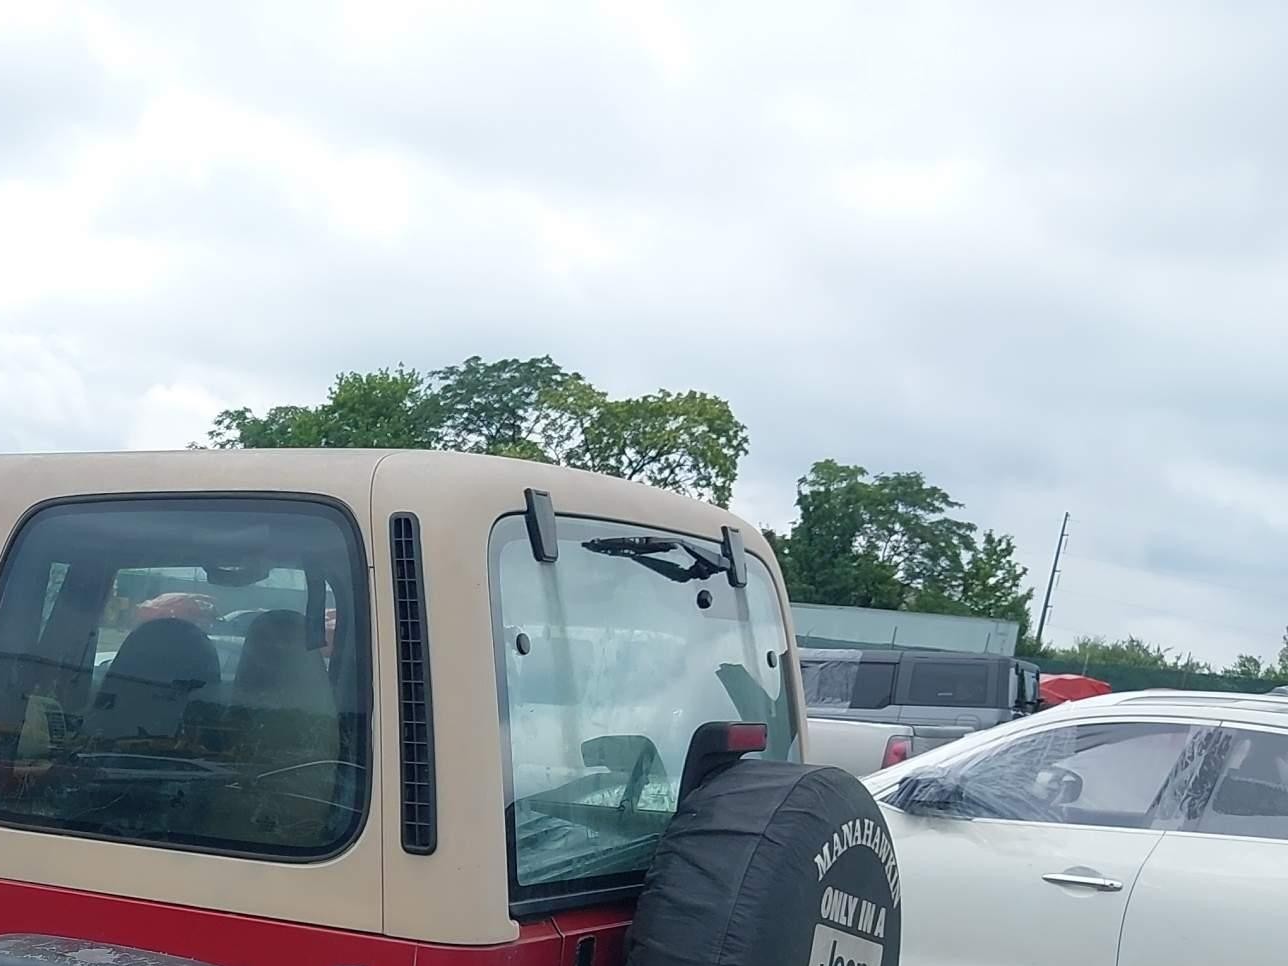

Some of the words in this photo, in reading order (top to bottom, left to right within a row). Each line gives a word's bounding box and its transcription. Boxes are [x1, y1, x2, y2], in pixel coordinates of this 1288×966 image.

[814, 818, 901, 909] MANAHAWKIN
[821, 886, 859, 928] ONLY
[858, 899, 876, 934] IN
[874, 907, 886, 938] A
